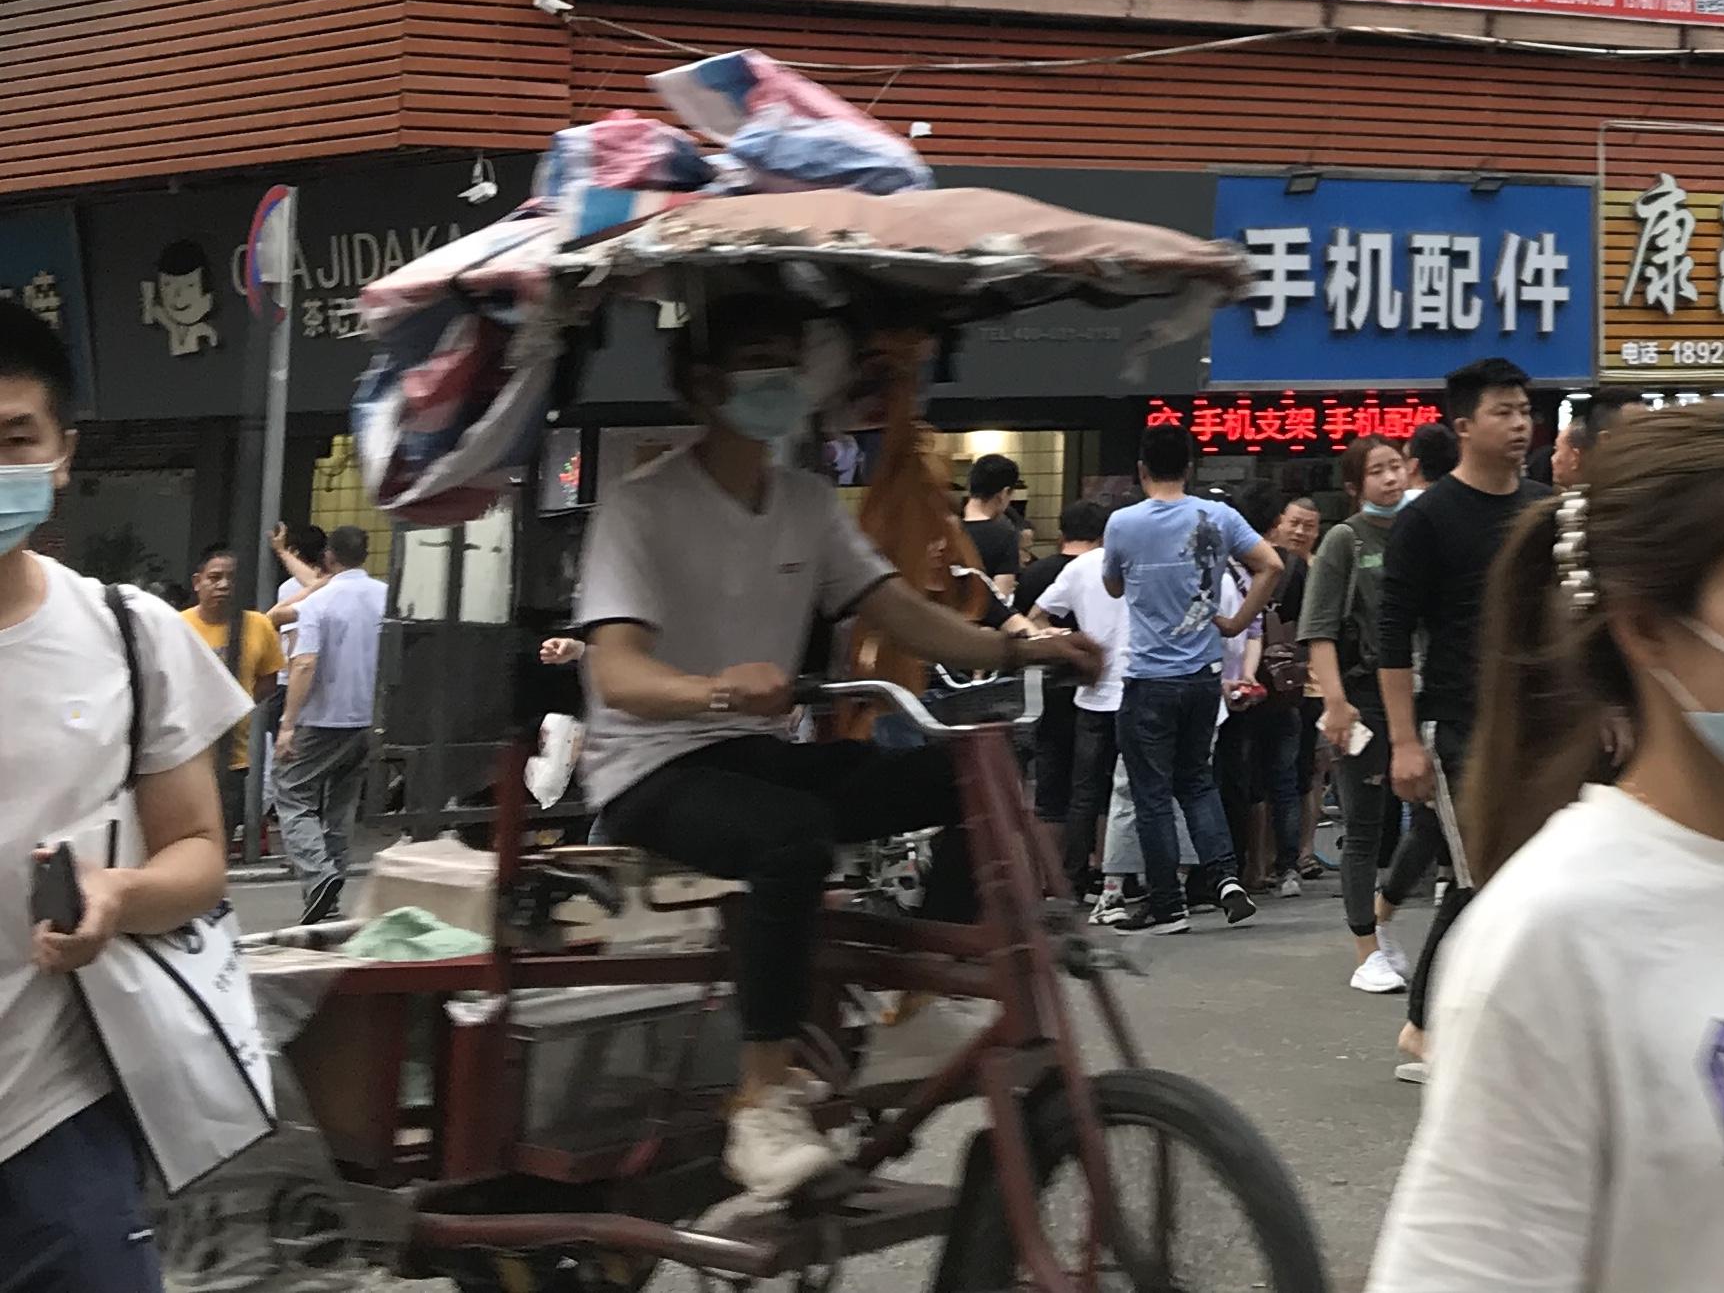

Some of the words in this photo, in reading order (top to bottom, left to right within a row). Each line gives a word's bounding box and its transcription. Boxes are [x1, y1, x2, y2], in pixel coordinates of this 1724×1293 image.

[1244, 227, 1570, 333] 手机配件
[1621, 341, 1658, 365] 电话
[1190, 407, 1317, 441] 手机支架
